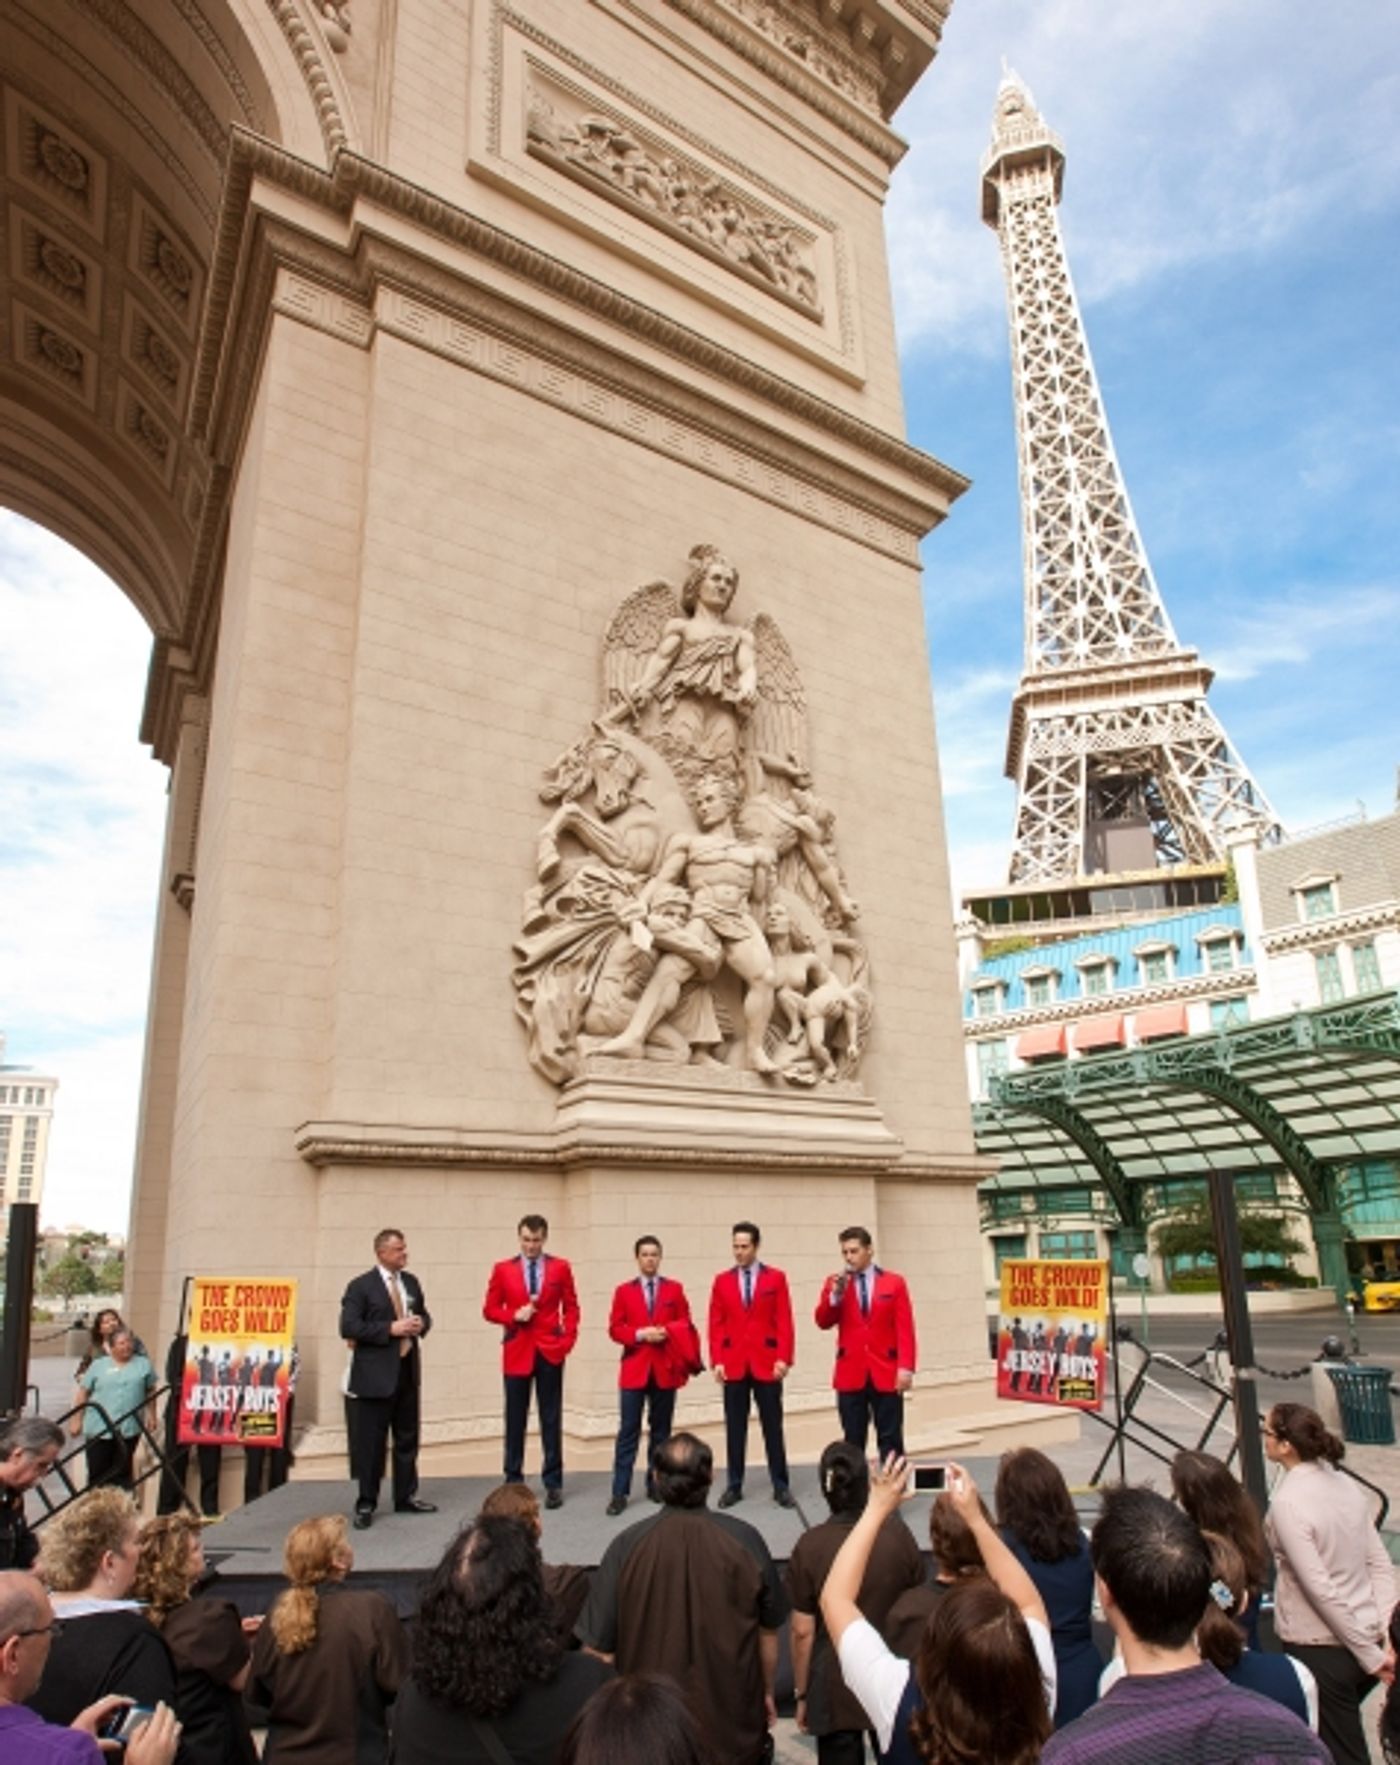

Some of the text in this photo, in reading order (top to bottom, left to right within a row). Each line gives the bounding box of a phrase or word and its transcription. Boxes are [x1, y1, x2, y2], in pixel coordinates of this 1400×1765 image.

[1041, 1264, 1101, 1286] CROWD
[233, 1285, 291, 1309] CROWD
[1009, 1285, 1049, 1307] GOES
[200, 1308, 239, 1333] GOES
[1001, 1349, 1057, 1376] JERSEY
[185, 1385, 242, 1415] JERSEY
